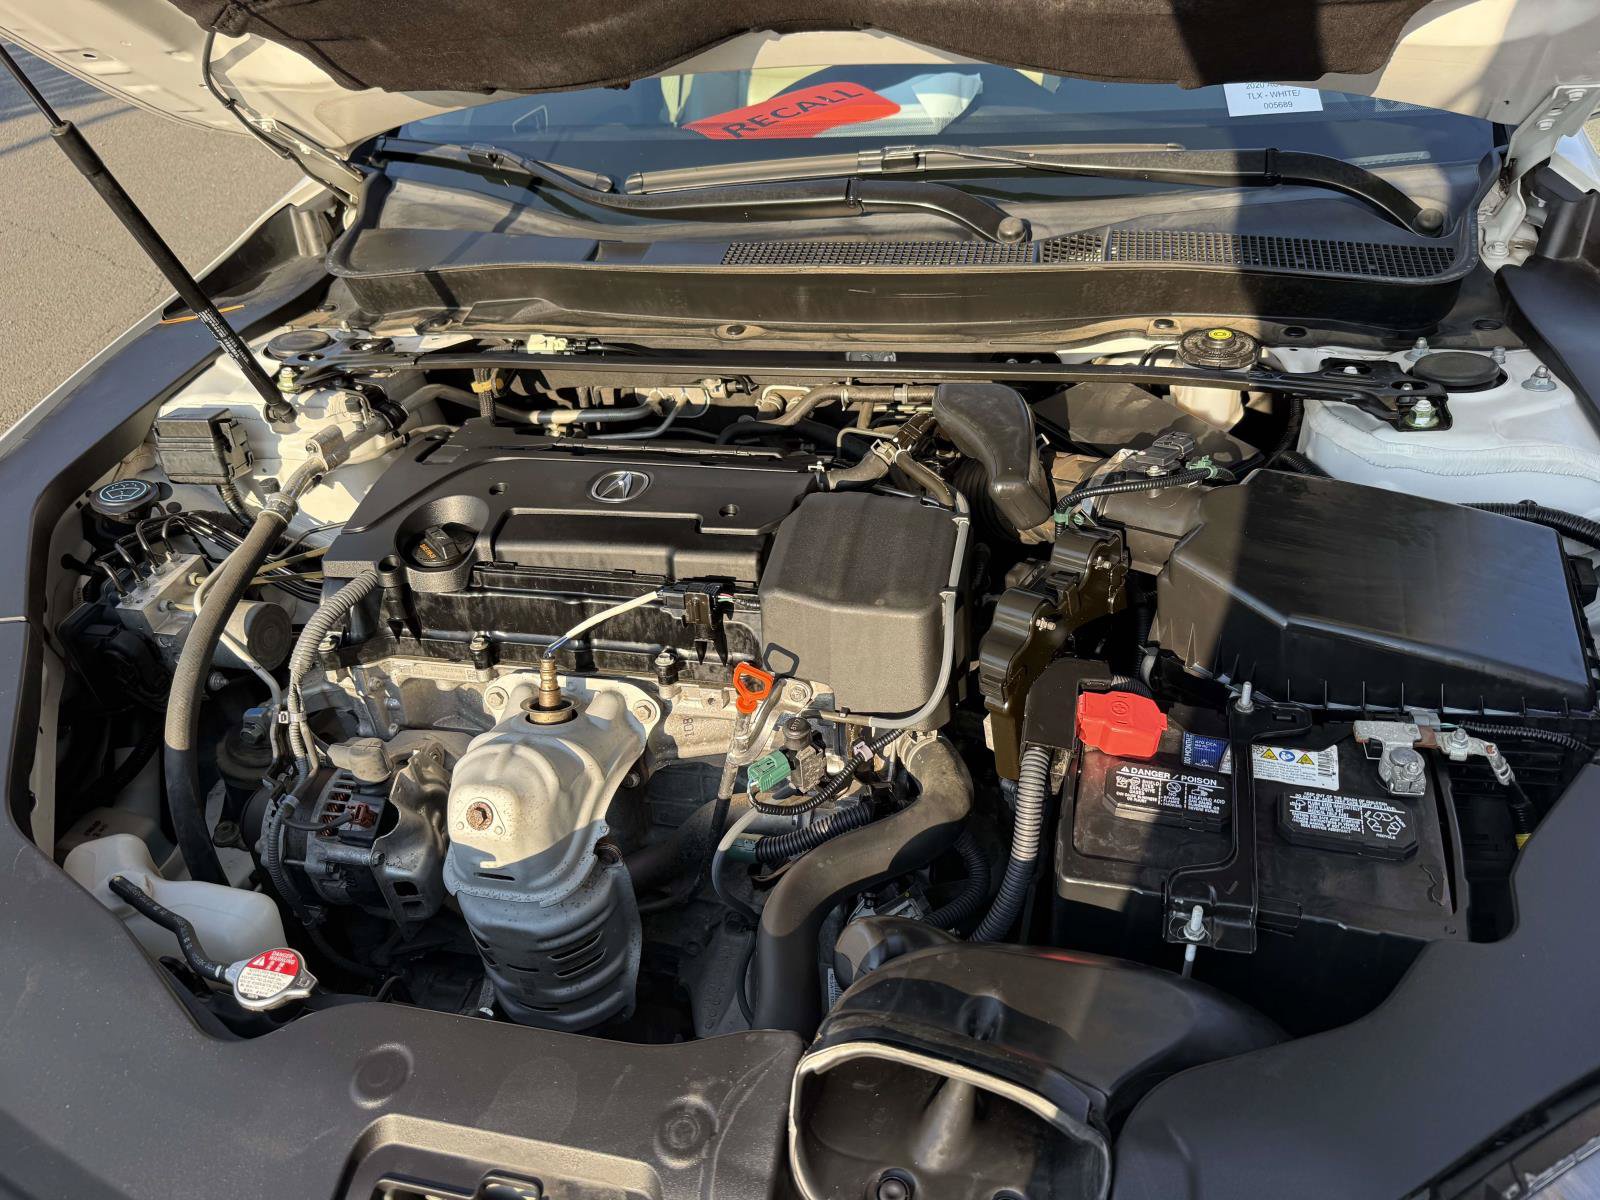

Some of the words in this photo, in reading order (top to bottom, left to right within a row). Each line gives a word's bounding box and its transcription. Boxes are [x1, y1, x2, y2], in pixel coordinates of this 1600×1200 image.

[1247, 92, 1263, 100] TLX
[1263, 101, 1293, 109] 005689
[722, 89, 863, 139] RECALL
[1131, 767, 1171, 780] DANGER
[1181, 774, 1217, 786] POISON
